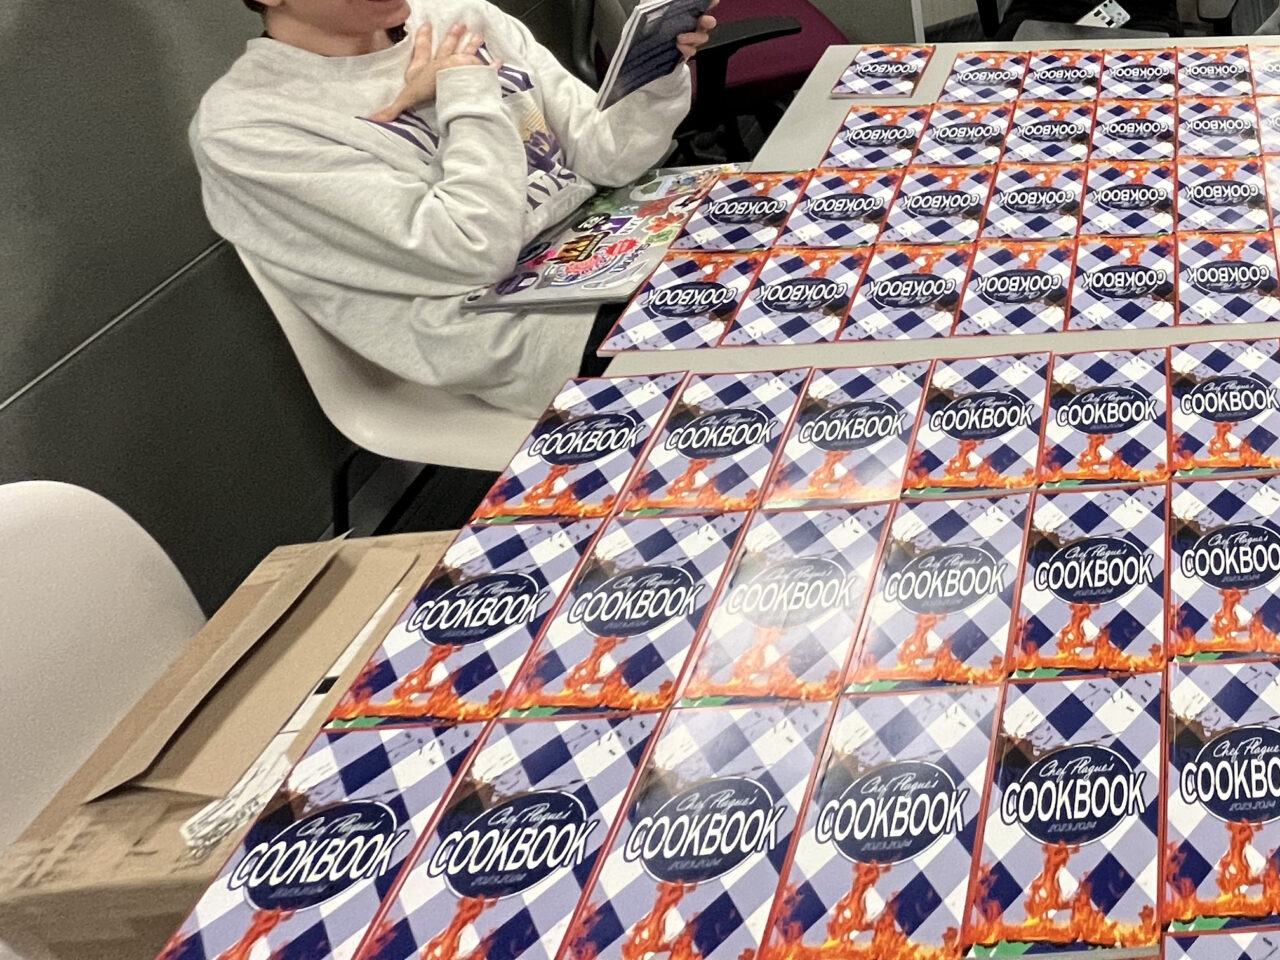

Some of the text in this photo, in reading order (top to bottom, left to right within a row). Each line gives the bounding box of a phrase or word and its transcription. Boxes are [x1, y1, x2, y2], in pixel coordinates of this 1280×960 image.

[843, 128, 915, 140] COOKBOOK
[930, 126, 1000, 138] COOKBOOK
[1015, 124, 1085, 135] COOKBOOK
[1100, 122, 1168, 133] COOKBOOK
[1186, 119, 1251, 130] COOKBOOK
[900, 194, 979, 209] COOKBOOK
[997, 191, 1073, 205] COOKBOOK
[1092, 188, 1166, 202] COOKBOOK
[1185, 184, 1258, 199] COOKBOOK
[703, 201, 787, 214] COOKBOOK
[802, 198, 883, 212] COOKBOOK
[975, 274, 1061, 293] COOKBOOK
[1082, 270, 1166, 288] COOKBOOK
[1187, 265, 1269, 283] COOKBOOK
[642, 288, 737, 306] COOKBOOK
[754, 283, 846, 301] COOKBOOK
[866, 279, 955, 297] COOKBOOK
[1057, 399, 1157, 426] COOKBOOK
[1181, 388, 1279, 414] COOKBOOK
[800, 414, 906, 444] COOKBOOK
[931, 405, 1034, 432] COOKBOOK
[531, 426, 645, 457] COOKBOOK
[666, 421, 777, 450] COOKBOOK
[885, 565, 1007, 601] COOKBOOK
[1035, 555, 1153, 591] COOKBOOK
[569, 585, 705, 623] COOKBOOK
[729, 578, 857, 614] COOKBOOK
[409, 593, 550, 632] COOKBOOK
[1213, 740, 1242, 763] Chef
[1039, 759, 1071, 783] Chef
[860, 775, 895, 800] Chef
[1003, 773, 1145, 824] COOKBOOK
[676, 792, 713, 818] Chef
[818, 791, 968, 842] COOKBOOK
[627, 808, 786, 861] COOKBOOK
[431, 821, 599, 876] COOKBOOK
[234, 833, 414, 889] COOKBOOK
